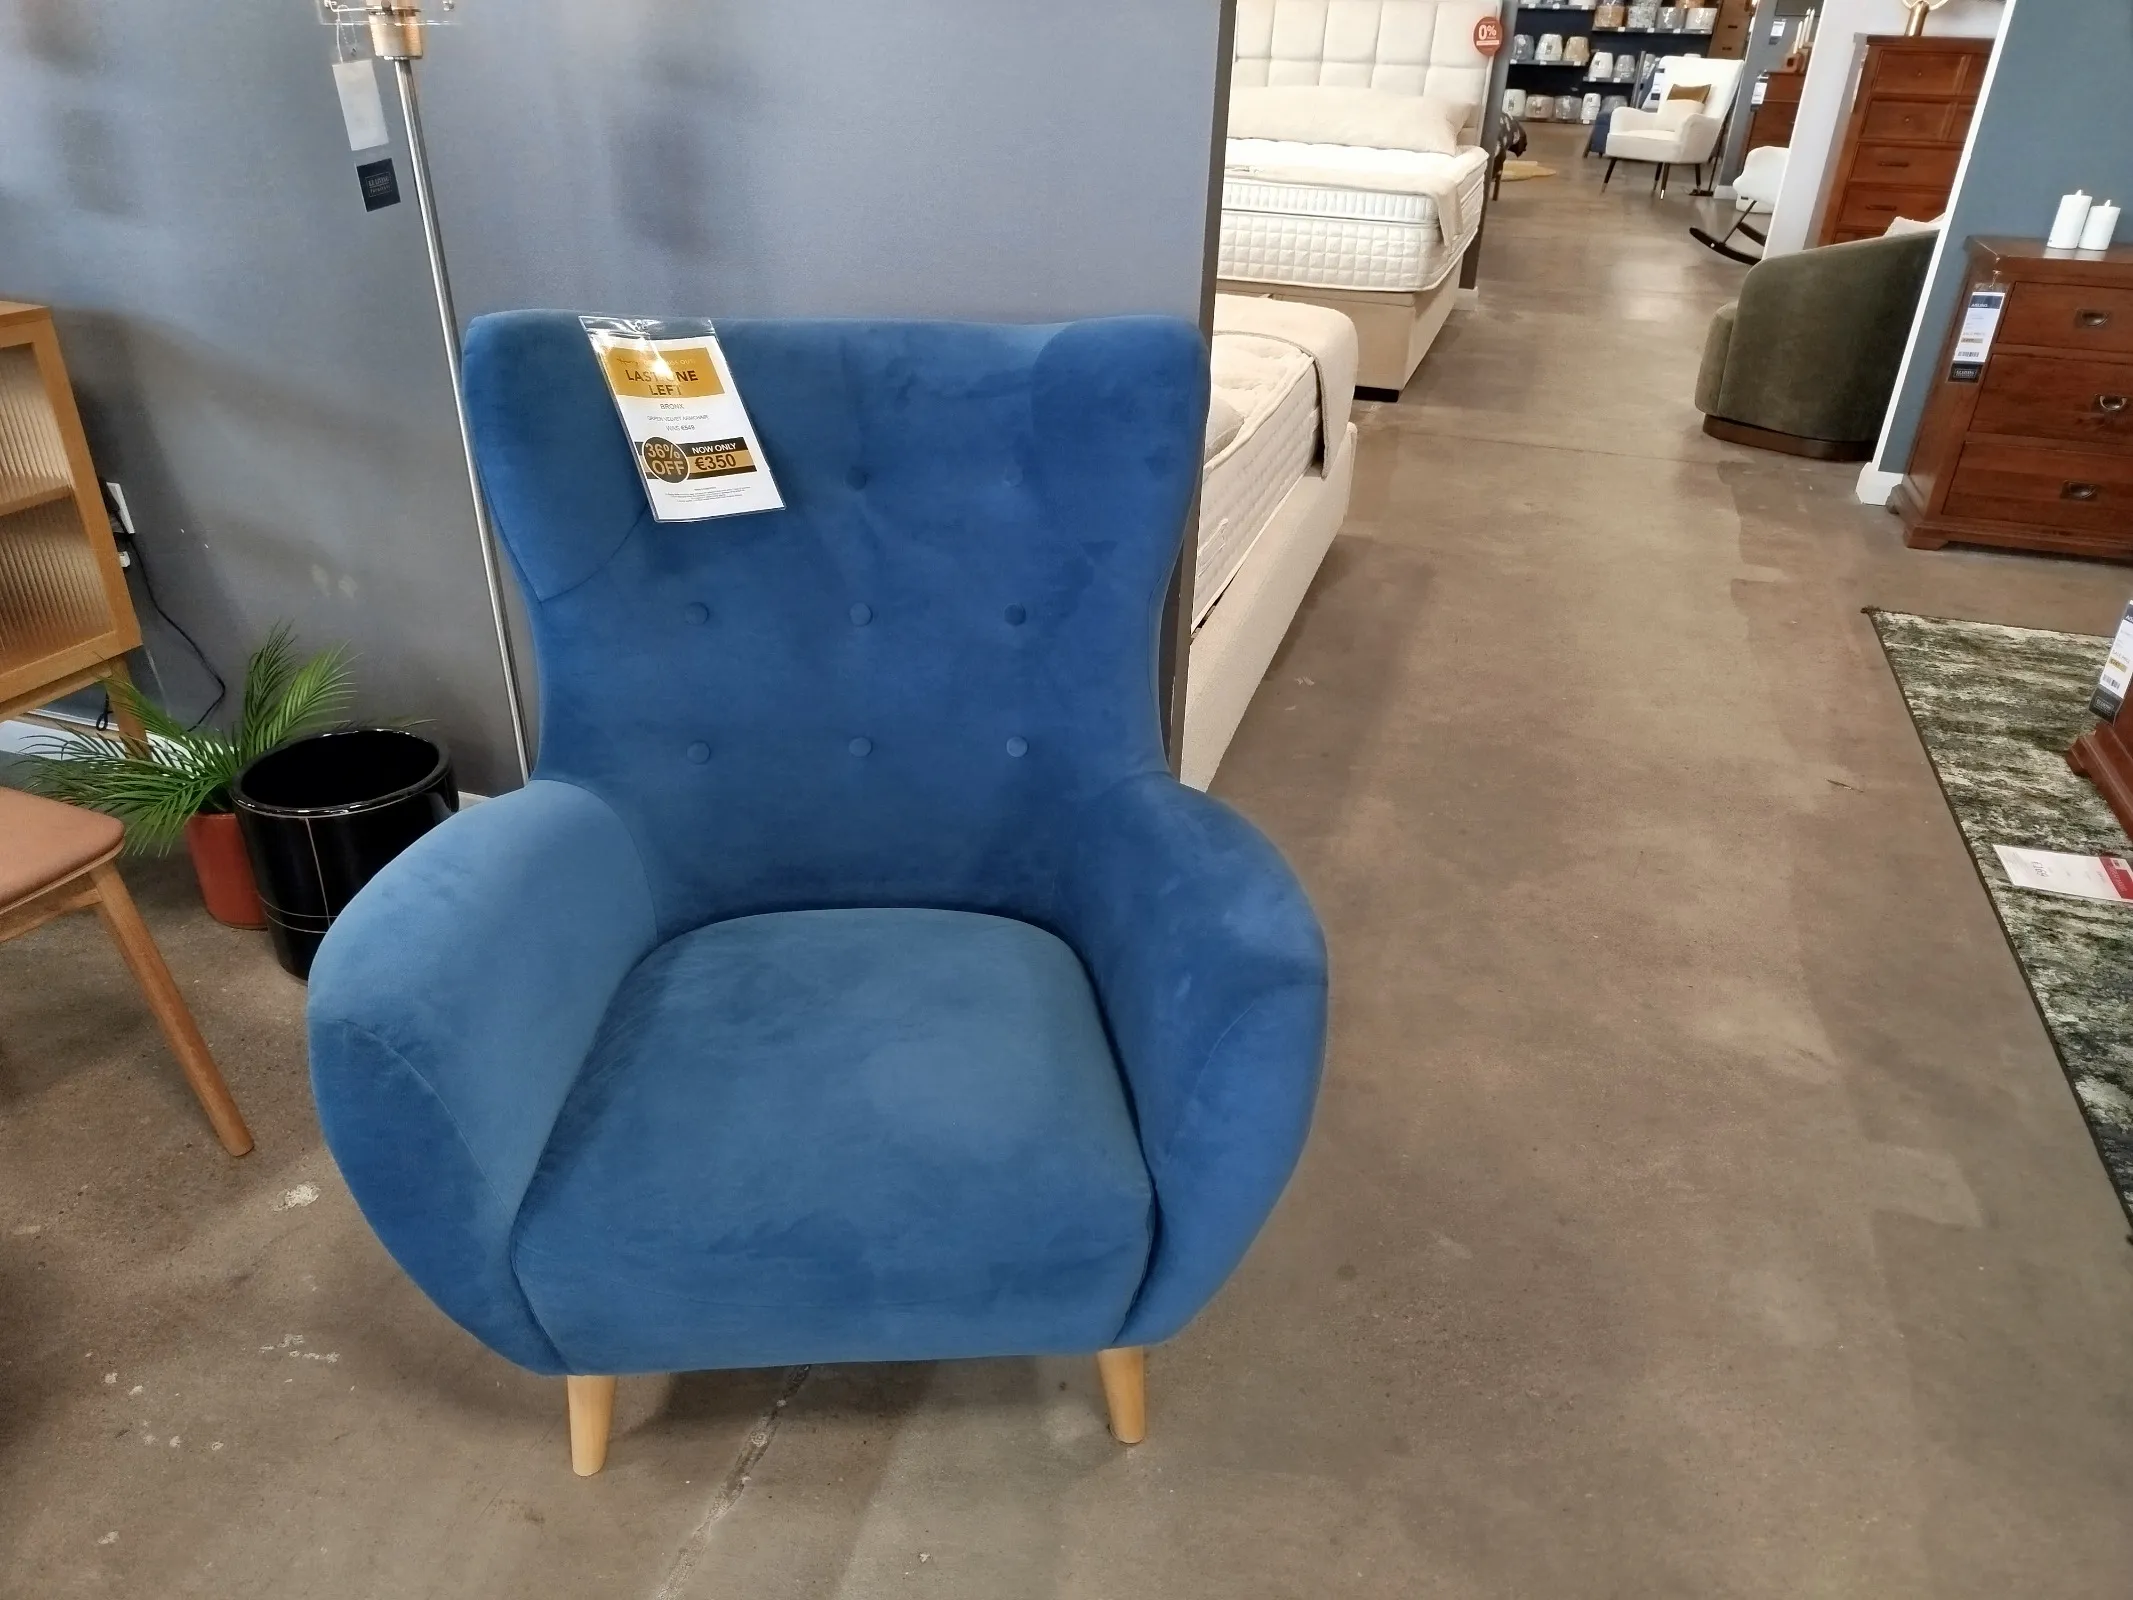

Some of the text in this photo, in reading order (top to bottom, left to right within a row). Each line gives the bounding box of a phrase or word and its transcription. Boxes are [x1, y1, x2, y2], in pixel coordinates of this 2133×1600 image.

[1478, 24, 1497, 41] 0%
[648, 384, 682, 396] LEFT
[645, 442, 737, 459] 36% NOW ONLY
[651, 453, 737, 476] OFF €350
